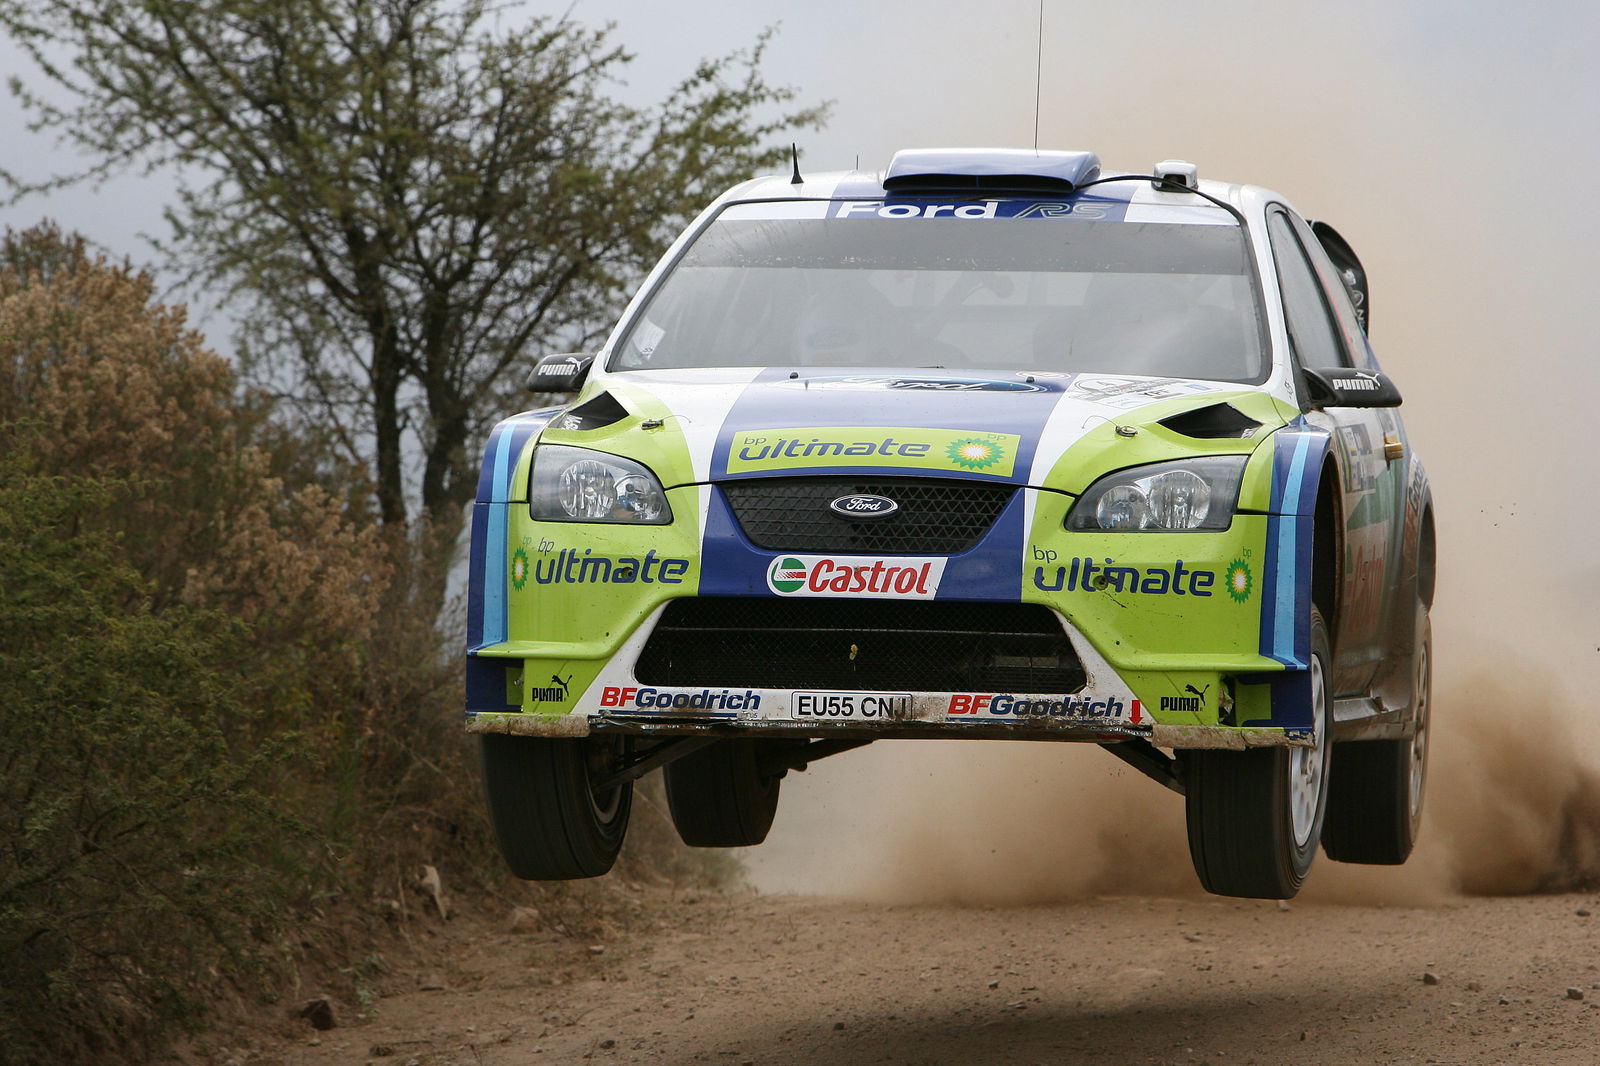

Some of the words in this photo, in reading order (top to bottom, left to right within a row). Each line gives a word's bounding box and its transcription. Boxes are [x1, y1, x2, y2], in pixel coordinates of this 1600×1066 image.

[835, 201, 999, 219] Ford
[1013, 203, 1113, 220] RS
[538, 364, 577, 375] PUMA
[1333, 378, 1375, 390] PUMA
[744, 437, 767, 446] bp
[987, 433, 1007, 441] bp
[739, 438, 931, 461] ultimate
[846, 498, 882, 511] Ford
[537, 536, 554, 556] bp
[1033, 545, 1057, 561] bp
[535, 548, 689, 584] ultimate
[808, 559, 932, 594] Castrol
[1034, 557, 1215, 596] ultimate
[532, 687, 564, 702] PUMA
[600, 687, 760, 710] BFGoodrich
[1160, 696, 1199, 711] PUMA
[798, 695, 854, 717] EU55
[948, 694, 1123, 718] BFGoodrich
